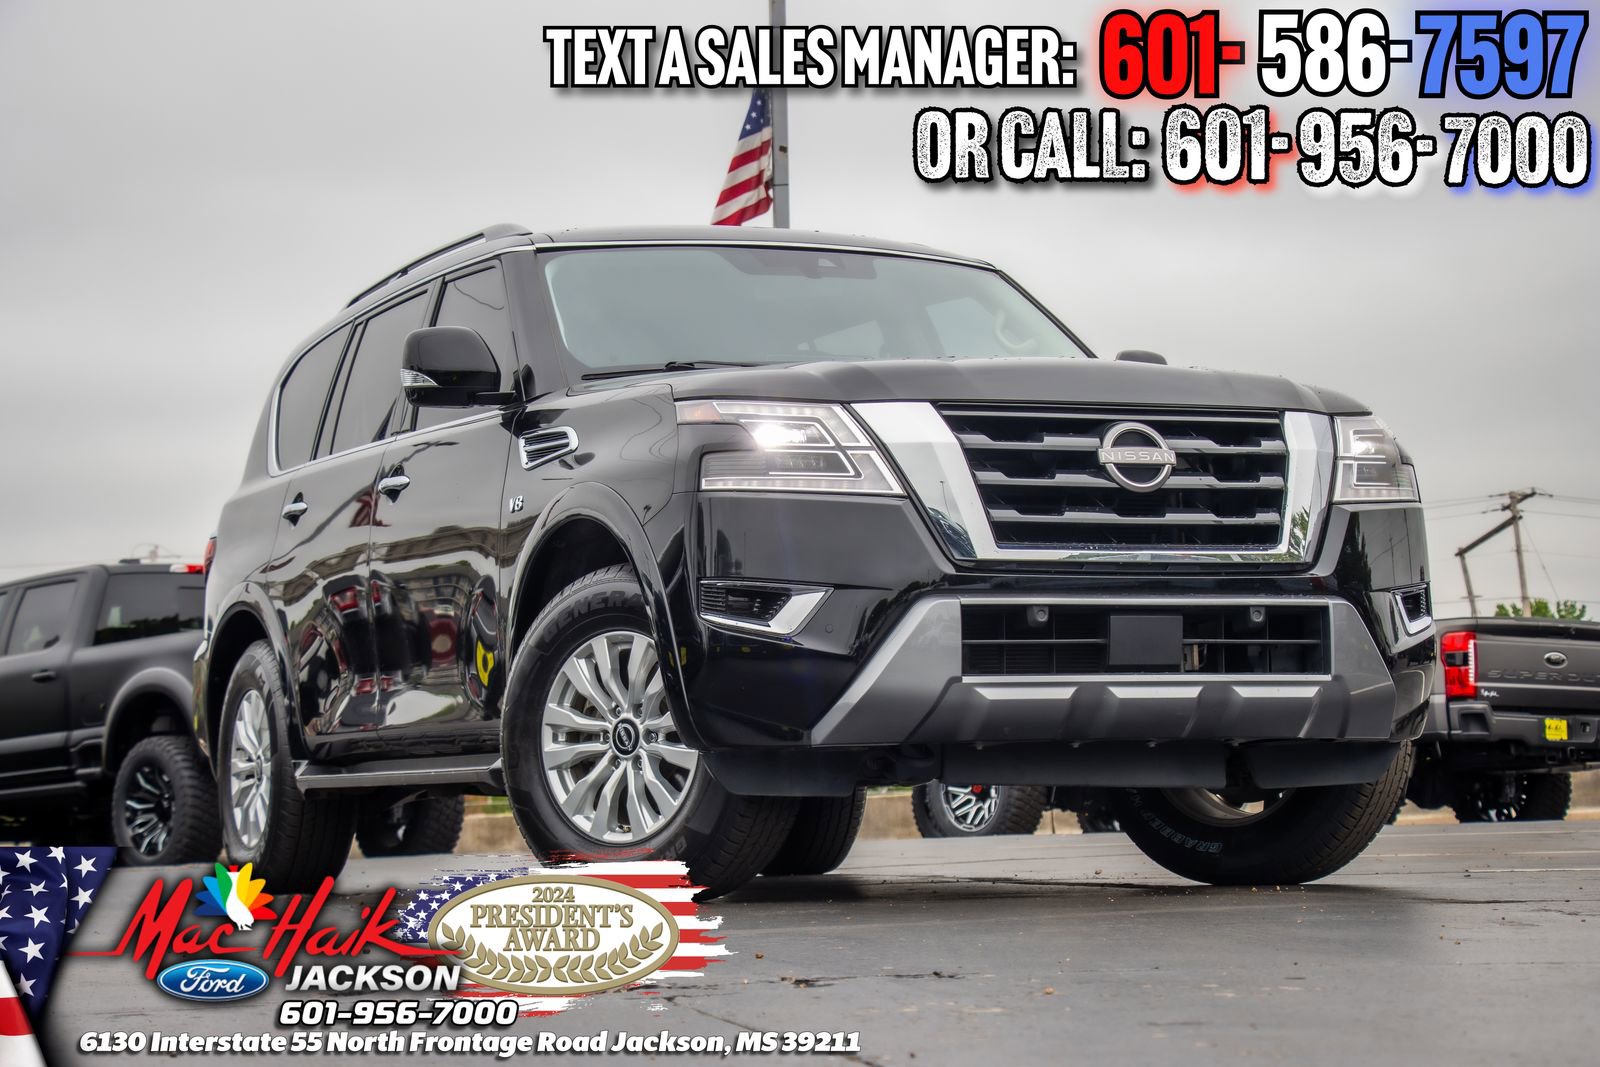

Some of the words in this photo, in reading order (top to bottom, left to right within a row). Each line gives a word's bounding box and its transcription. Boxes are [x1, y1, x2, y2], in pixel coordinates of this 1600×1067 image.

[1101, 450, 1175, 462] NISSAN
[509, 495, 524, 513] V8
[543, 590, 645, 642] GENERA
[1488, 670, 1562, 681] SUPER
